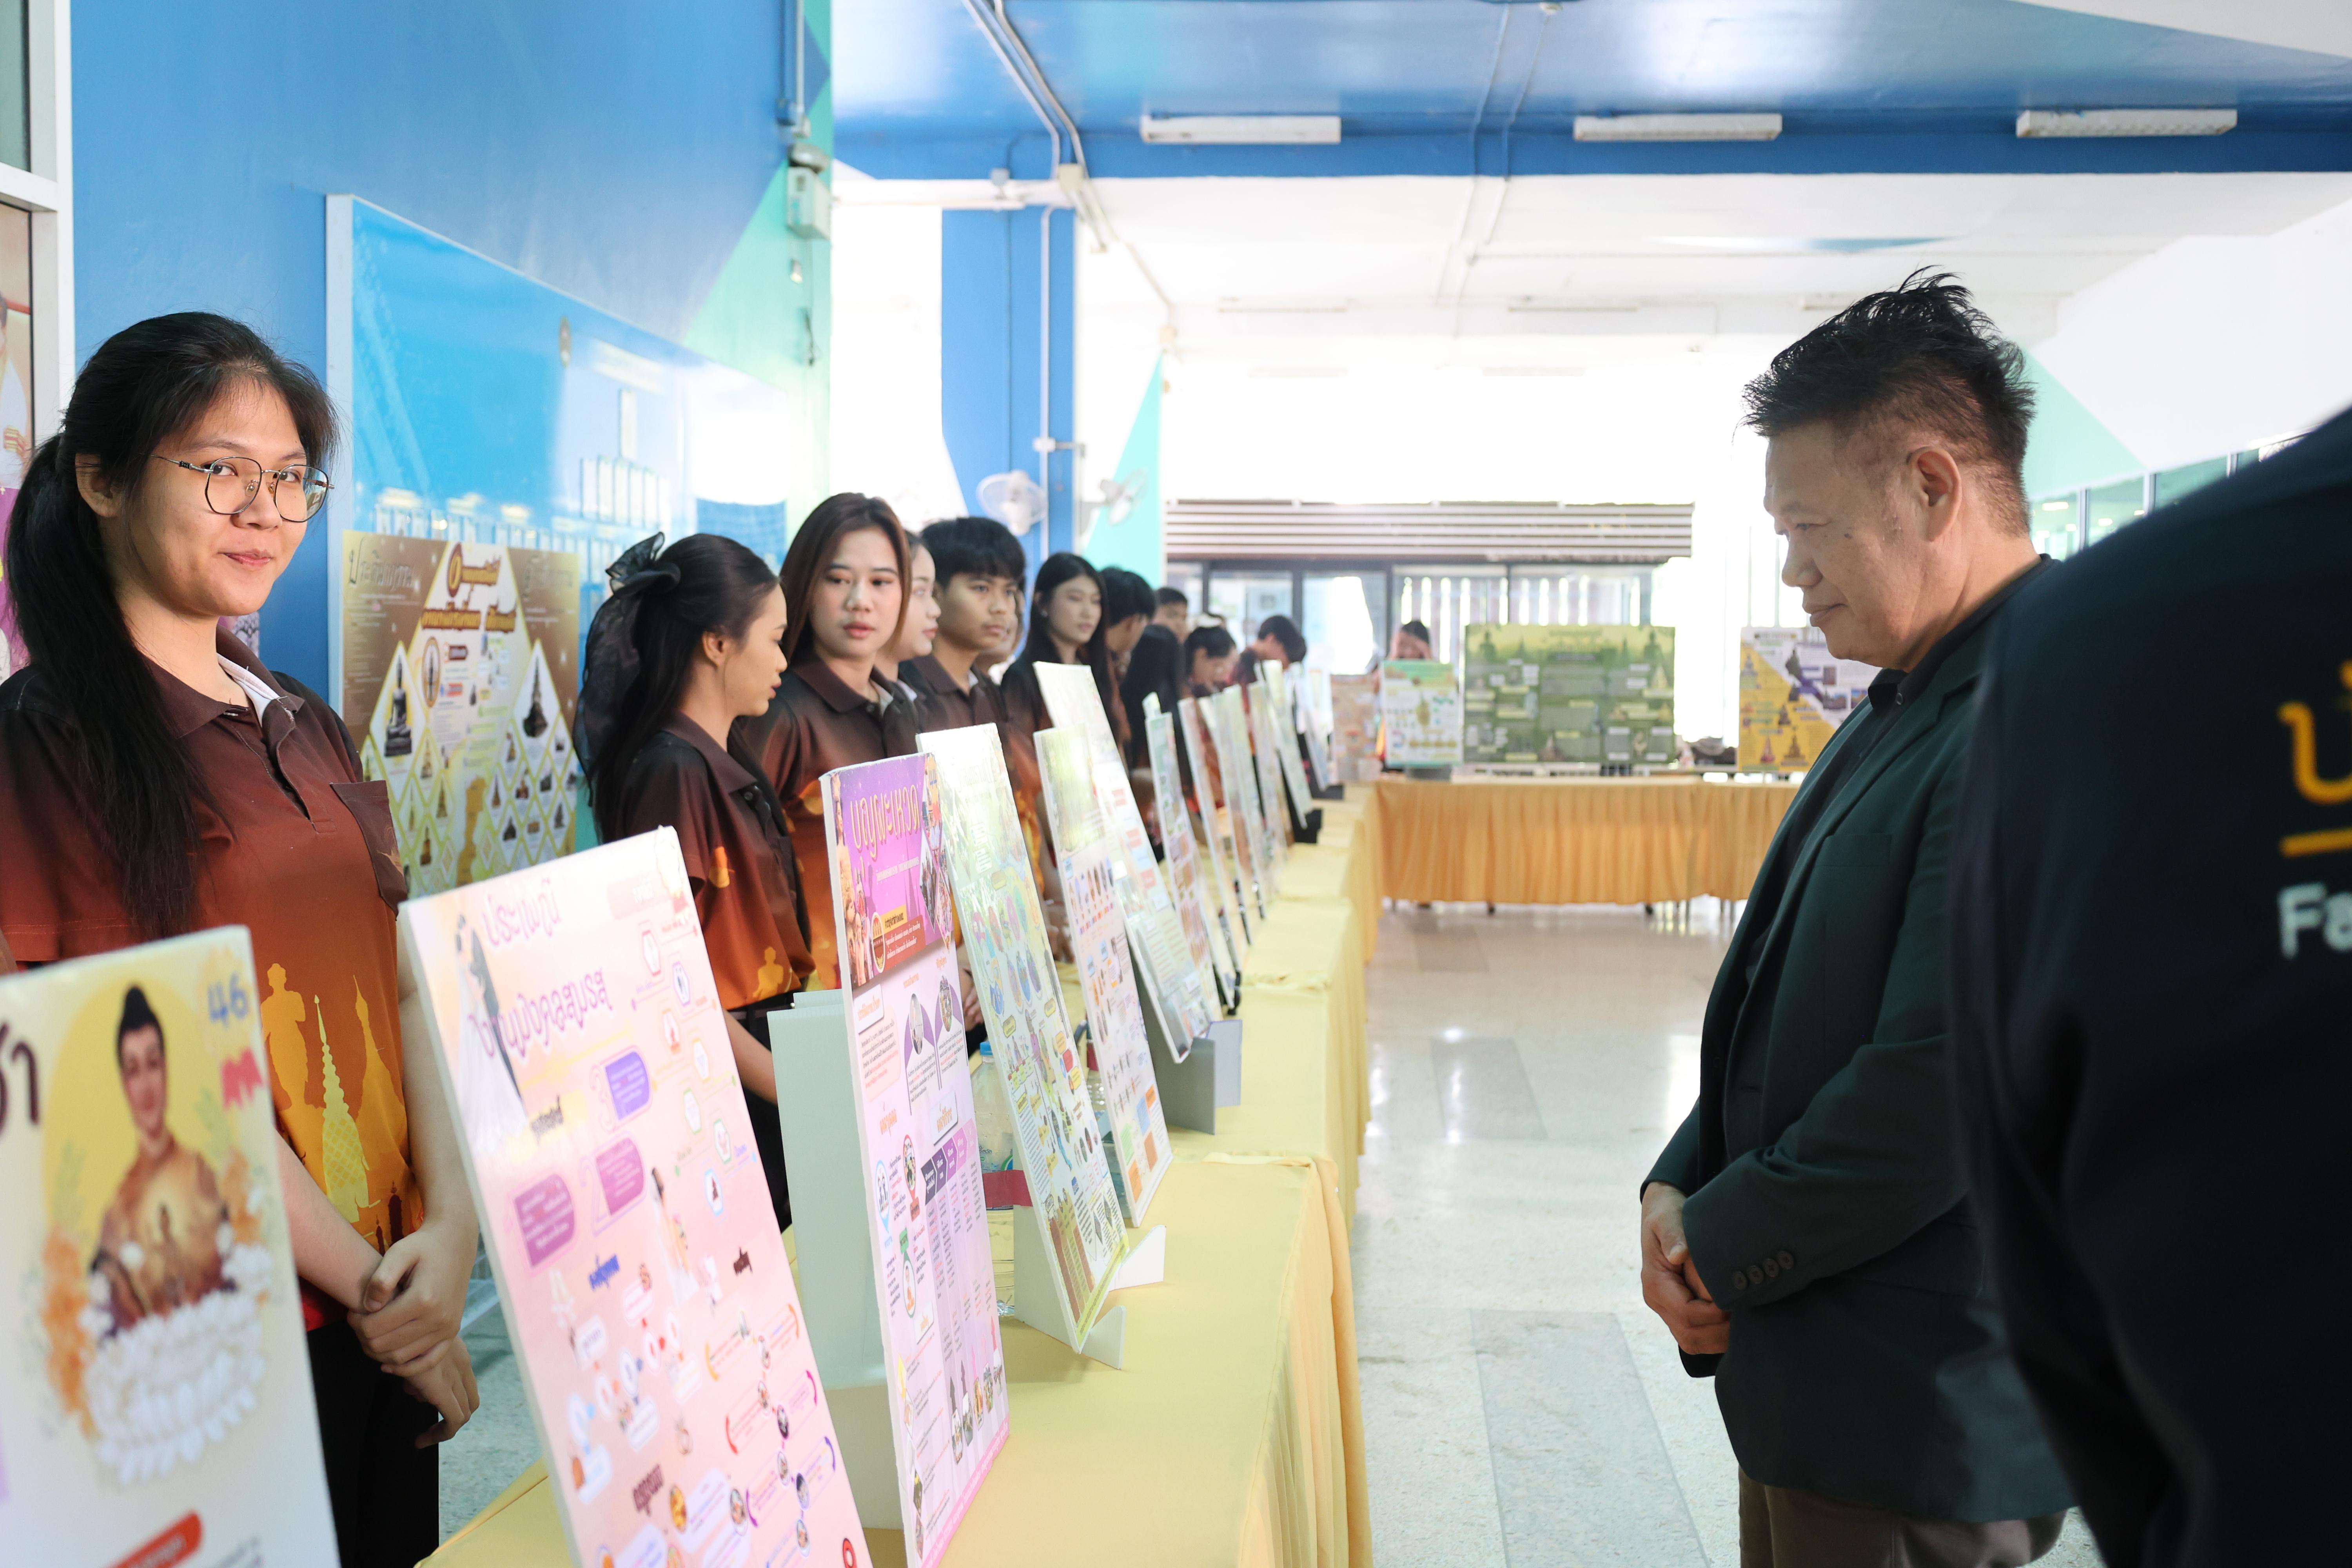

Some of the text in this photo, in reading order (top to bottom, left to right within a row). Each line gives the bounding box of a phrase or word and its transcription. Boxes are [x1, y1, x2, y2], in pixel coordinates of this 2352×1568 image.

[482, 877, 562, 947] ประเพณี
[207, 972, 249, 1028] 46
